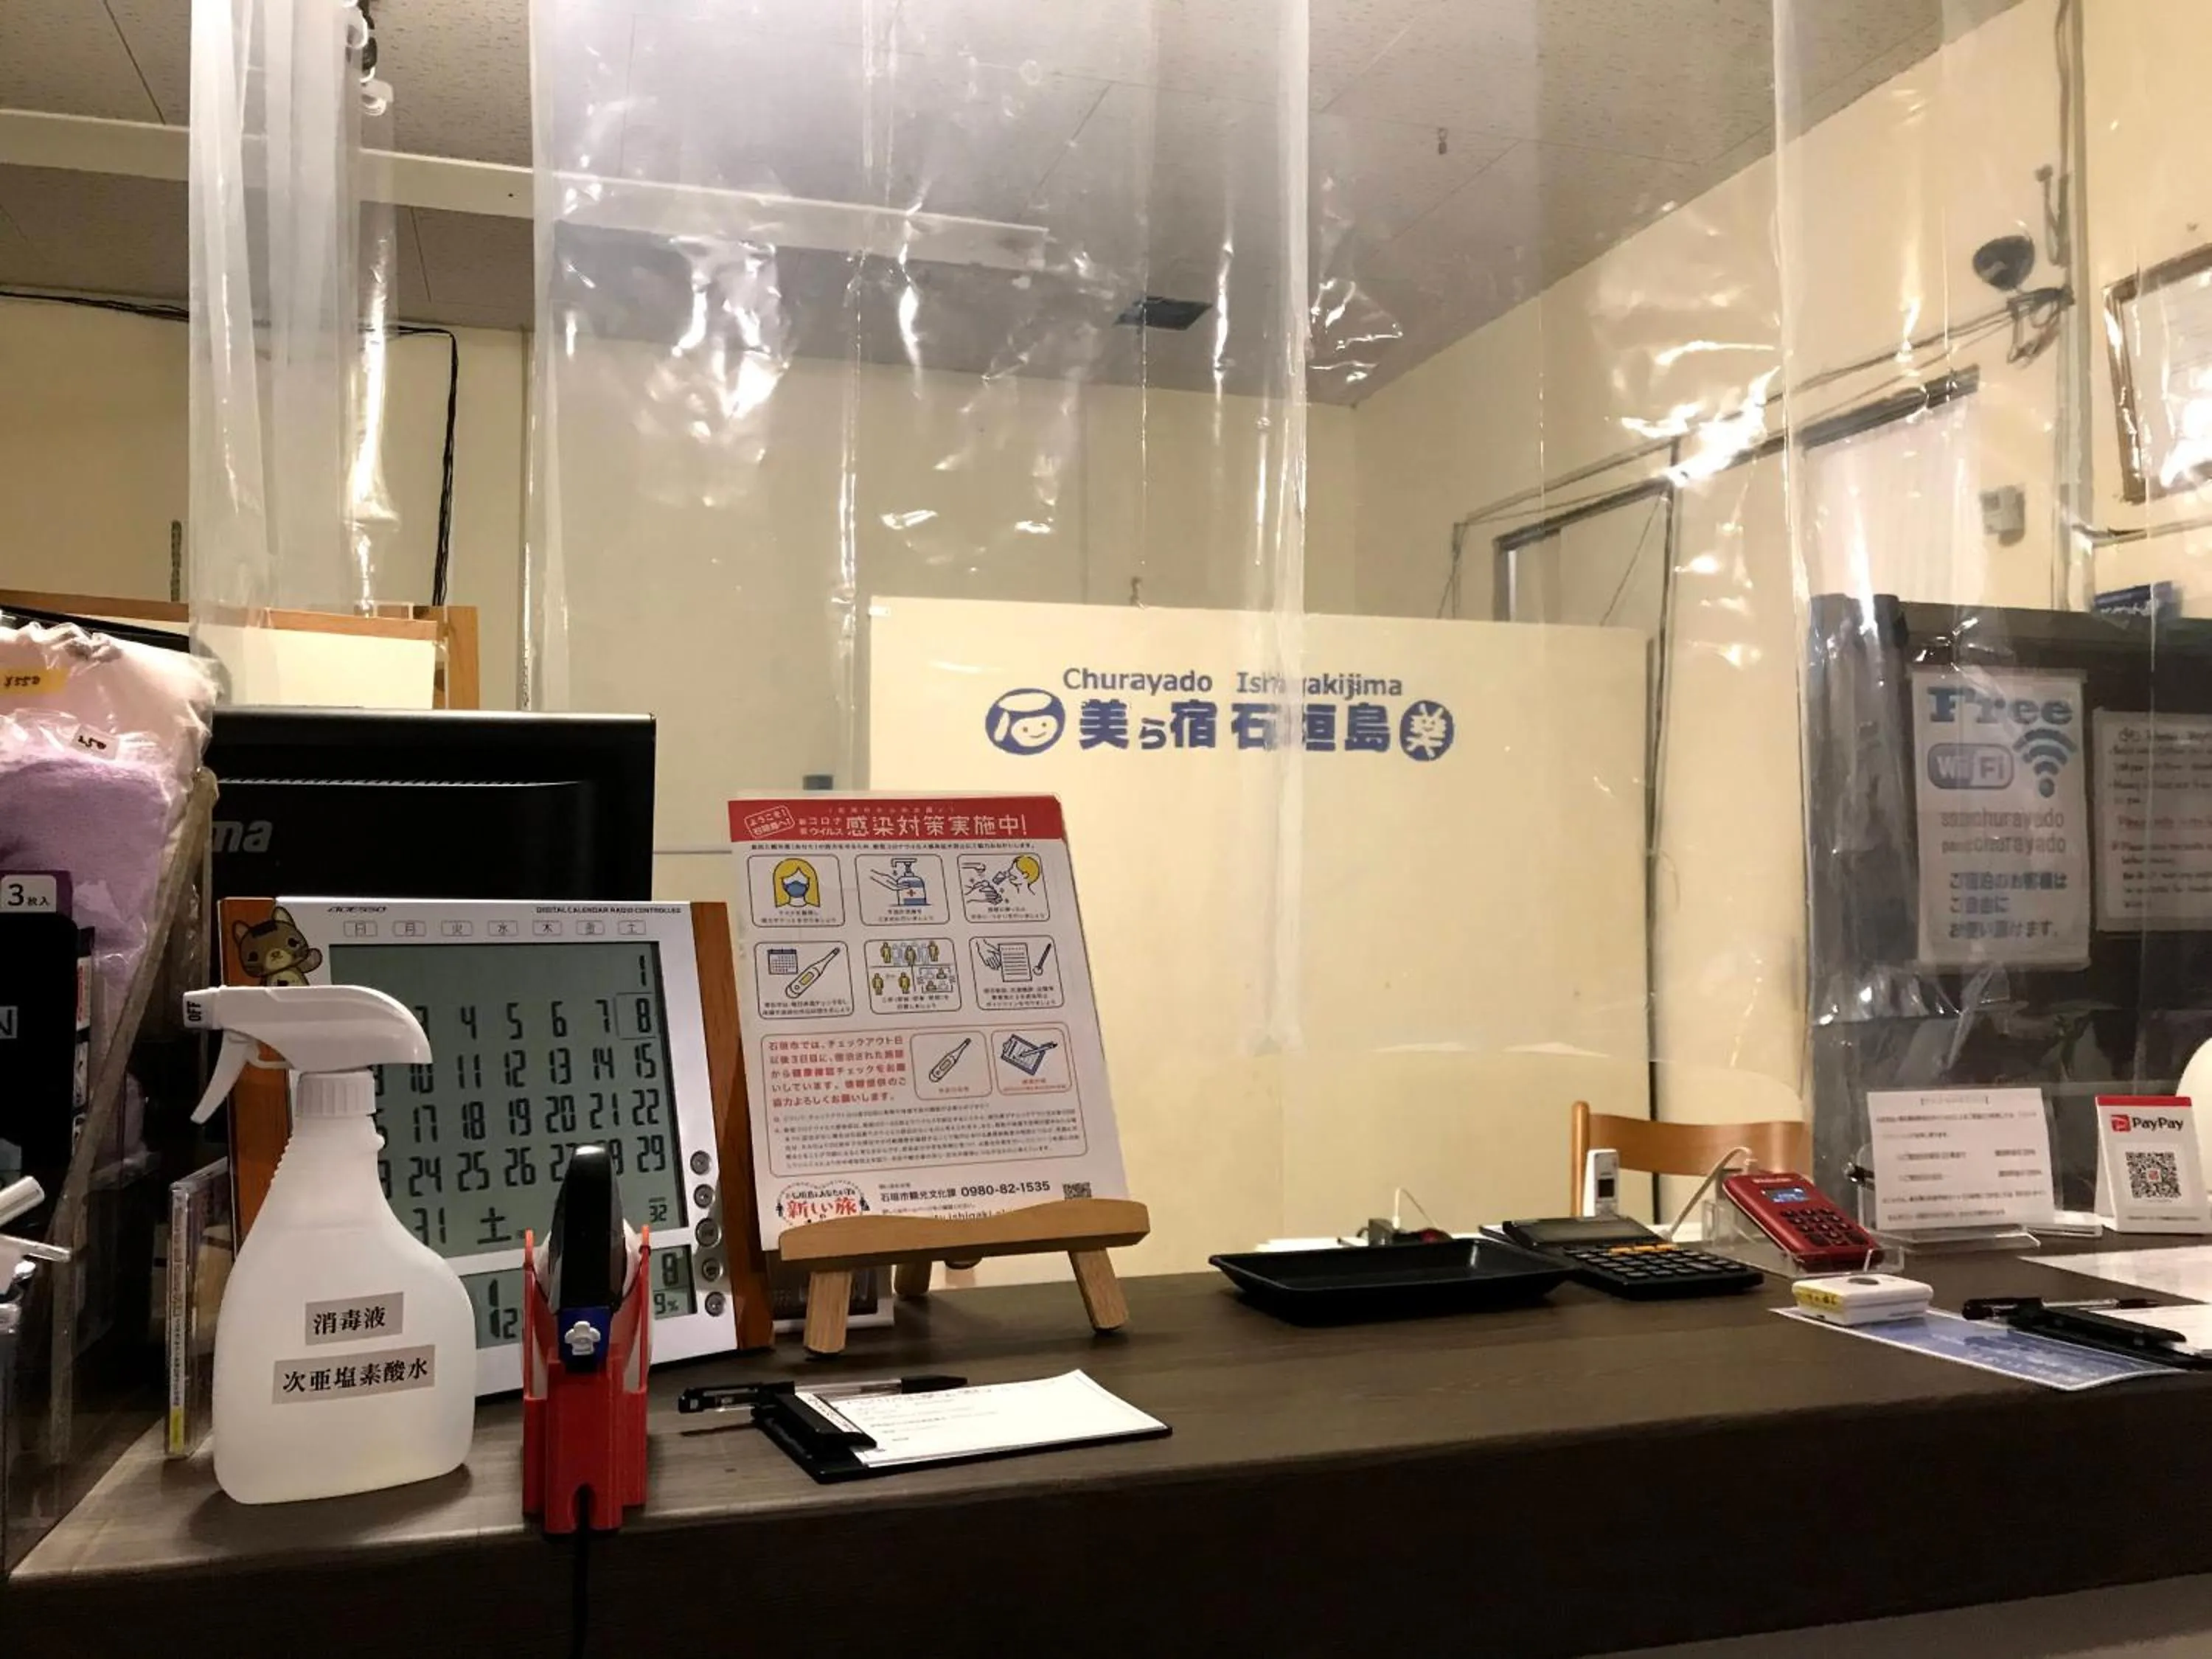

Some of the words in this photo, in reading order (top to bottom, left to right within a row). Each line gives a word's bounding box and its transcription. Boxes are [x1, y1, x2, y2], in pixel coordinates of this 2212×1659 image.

[1062, 667, 1213, 696] Churayado
[1237, 672, 1403, 700] Ishakijima
[1927, 686, 2073, 726] Free
[639, 954, 647, 987] 1
[187, 1001, 201, 1021] OFF
[459, 1005, 478, 1040] 4
[506, 1002, 524, 1040] 5
[551, 1001, 567, 1038] 6
[595, 999, 611, 1034] 7
[636, 998, 652, 1034] 8
[410, 1063, 434, 1093] 10
[457, 1054, 481, 1089] 11
[504, 1049, 526, 1088] 12
[549, 1047, 572, 1085] 13
[592, 1046, 615, 1081] 14
[634, 1043, 657, 1079] 15
[413, 1105, 438, 1143] 17
[462, 1101, 486, 1141] 18
[509, 1098, 531, 1136] 19
[545, 1094, 577, 1134] 20
[589, 1093, 621, 1130] 21
[632, 1088, 660, 1127] 22
[2132, 1116, 2184, 1131] PayPay
[408, 1156, 442, 1197] 24
[457, 1151, 490, 1192] 25
[504, 1147, 536, 1187] 26
[636, 1135, 665, 1173] 29
[960, 1180, 1051, 1198] 0980-82-1535
[787, 1196, 858, 1219] 新しい旅
[412, 1206, 446, 1246] 31
[477, 1206, 512, 1245] 土
[313, 1305, 386, 1336] 消毒液
[282, 1357, 428, 1393] 次亜塩素酸水
